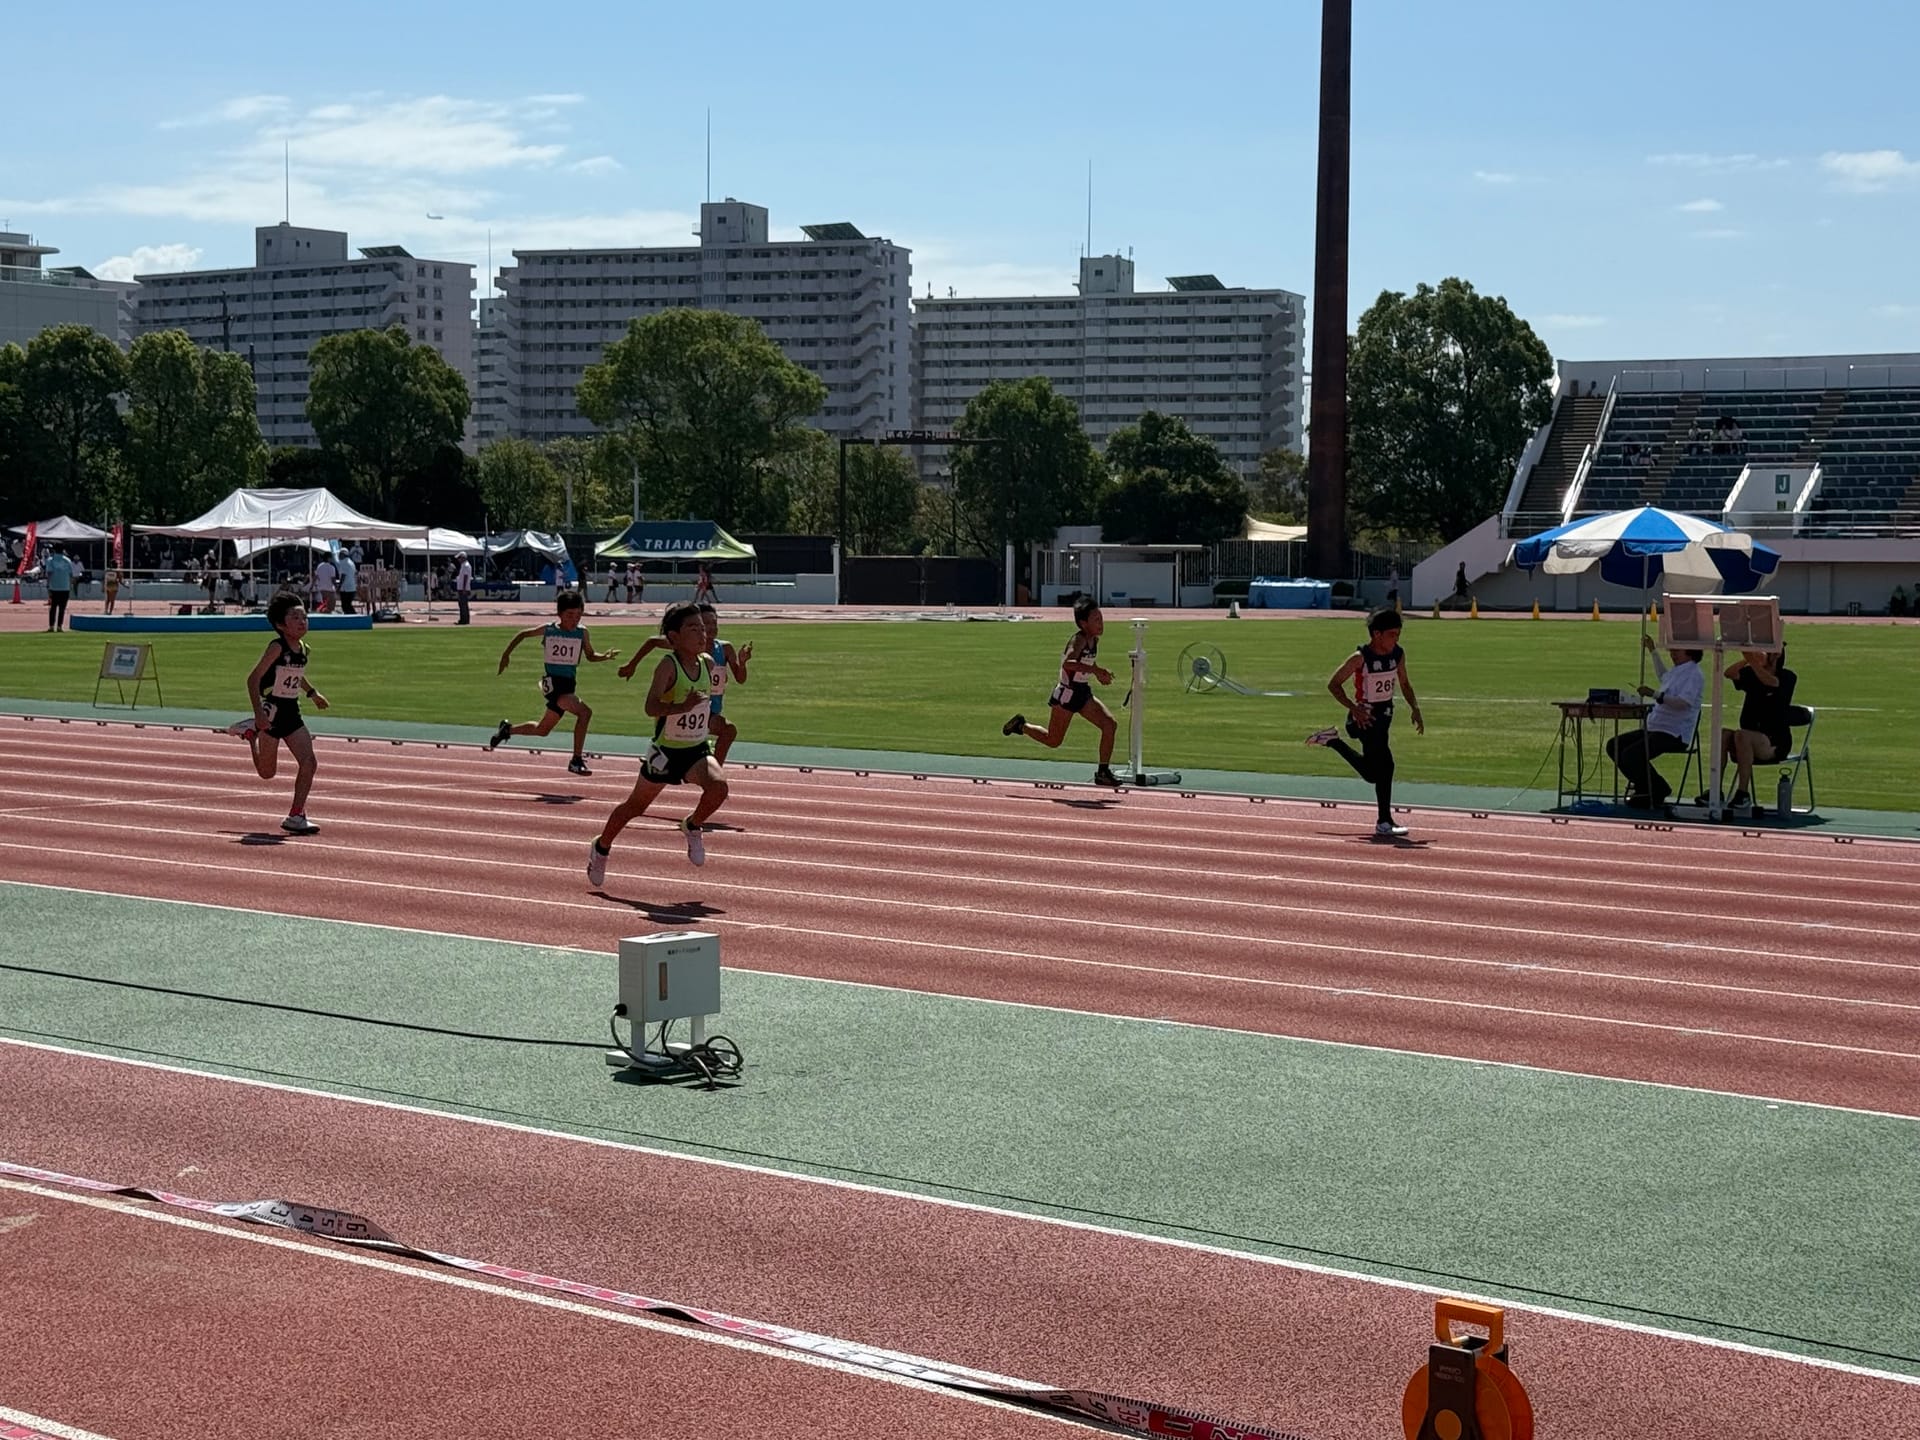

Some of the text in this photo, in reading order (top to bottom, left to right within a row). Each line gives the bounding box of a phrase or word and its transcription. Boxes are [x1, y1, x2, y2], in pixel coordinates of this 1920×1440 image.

[1778, 476, 1787, 491] J
[644, 538, 727, 551] TRIANGLE
[552, 644, 574, 657] 201
[677, 713, 705, 730] 492
[270, 1206, 291, 1217] 3
[299, 1213, 314, 1224] 4
[321, 1217, 335, 1228] 5
[346, 1222, 367, 1233] 6
